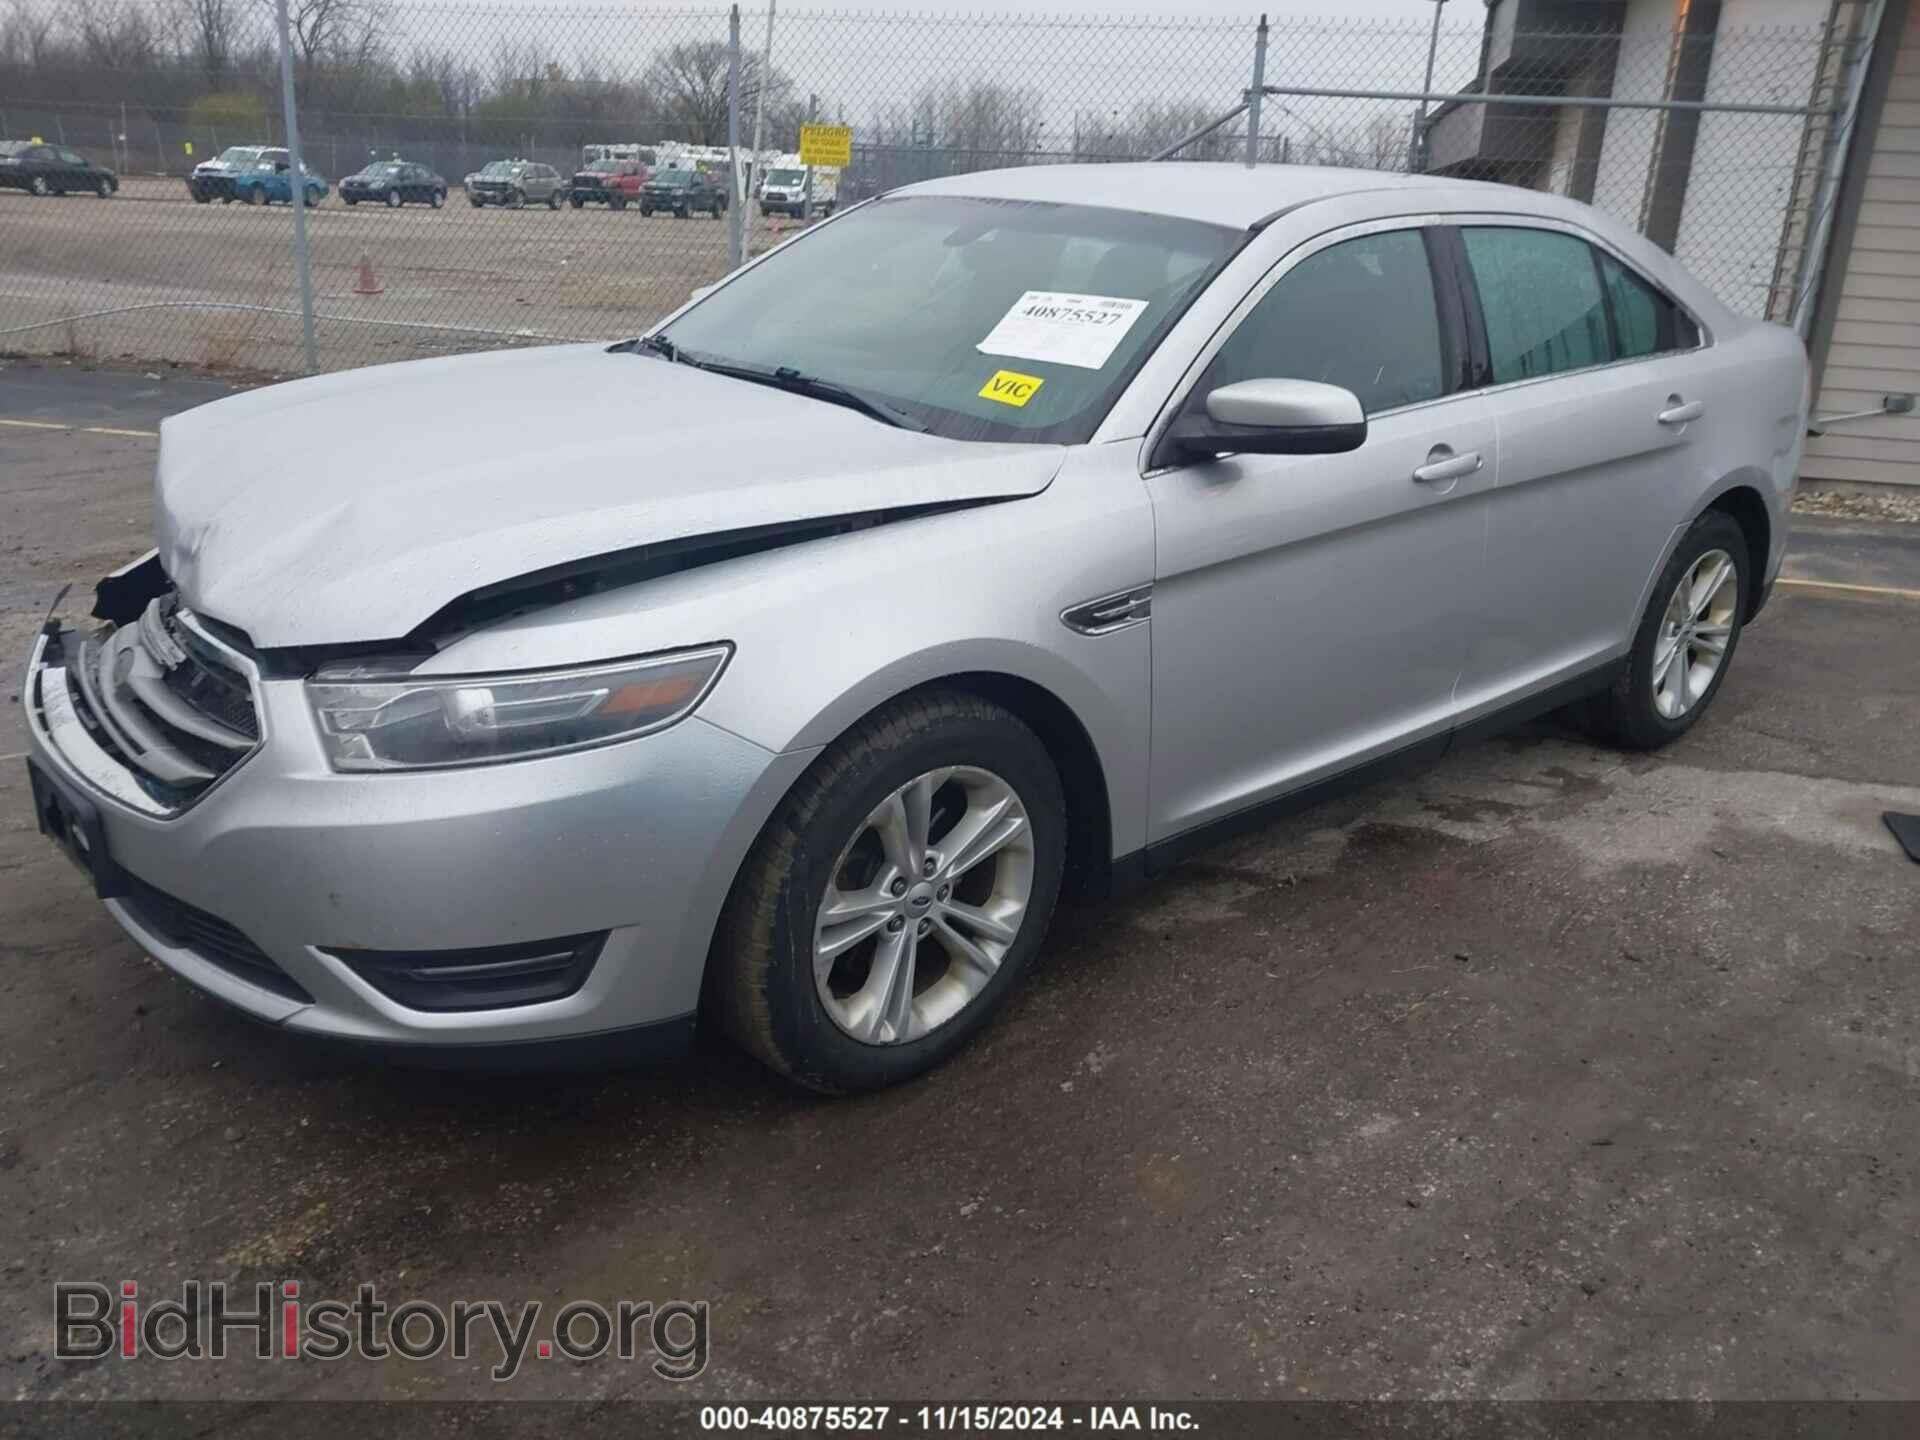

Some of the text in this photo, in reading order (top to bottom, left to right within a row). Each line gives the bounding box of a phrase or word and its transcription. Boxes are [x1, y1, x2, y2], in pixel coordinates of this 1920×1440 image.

[803, 127, 849, 137] PELIGRO
[1022, 304, 1122, 327] 40875527
[992, 377, 1032, 398] VIC
